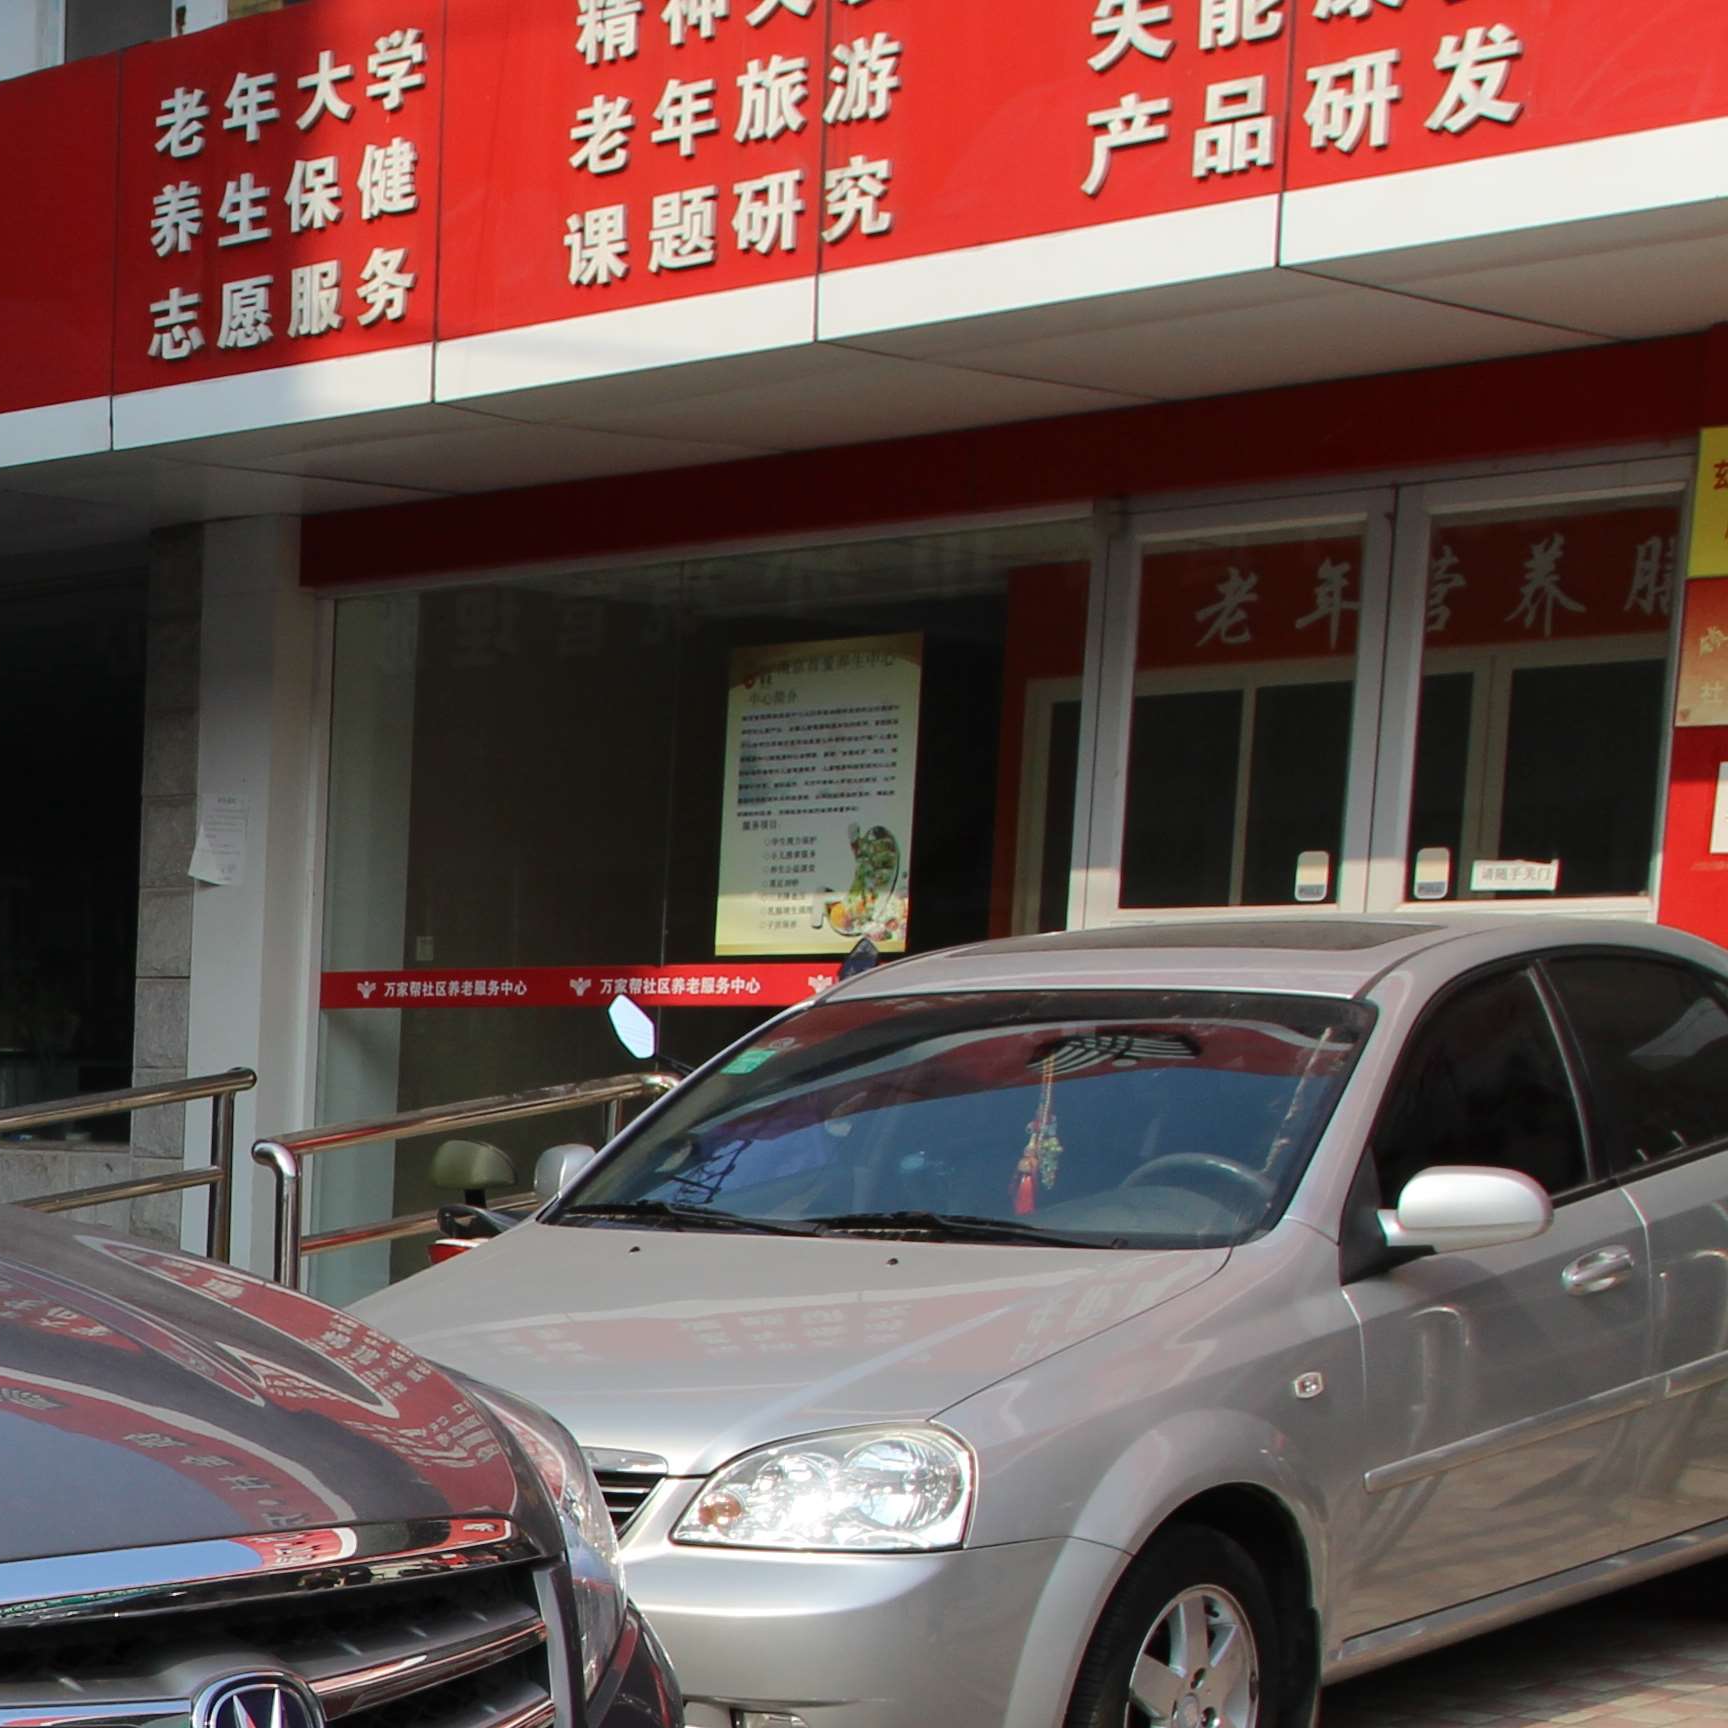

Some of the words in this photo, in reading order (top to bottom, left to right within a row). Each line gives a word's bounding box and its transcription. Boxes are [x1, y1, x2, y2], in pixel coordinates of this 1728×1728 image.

[575, 0, 872, 66] 精神
[1086, 0, 1472, 72] 失能
[155, 28, 428, 161] 老年大学
[568, 31, 903, 177] 老年旅游
[1080, 22, 1525, 198] 产品研发
[150, 136, 420, 258] 养生保健
[562, 155, 894, 288] 课题研究
[147, 246, 417, 361] 志愿服务
[384, 978, 528, 998] 万家帮社区养老服务中心
[600, 976, 761, 997] 万家帮社区养老服务中心
